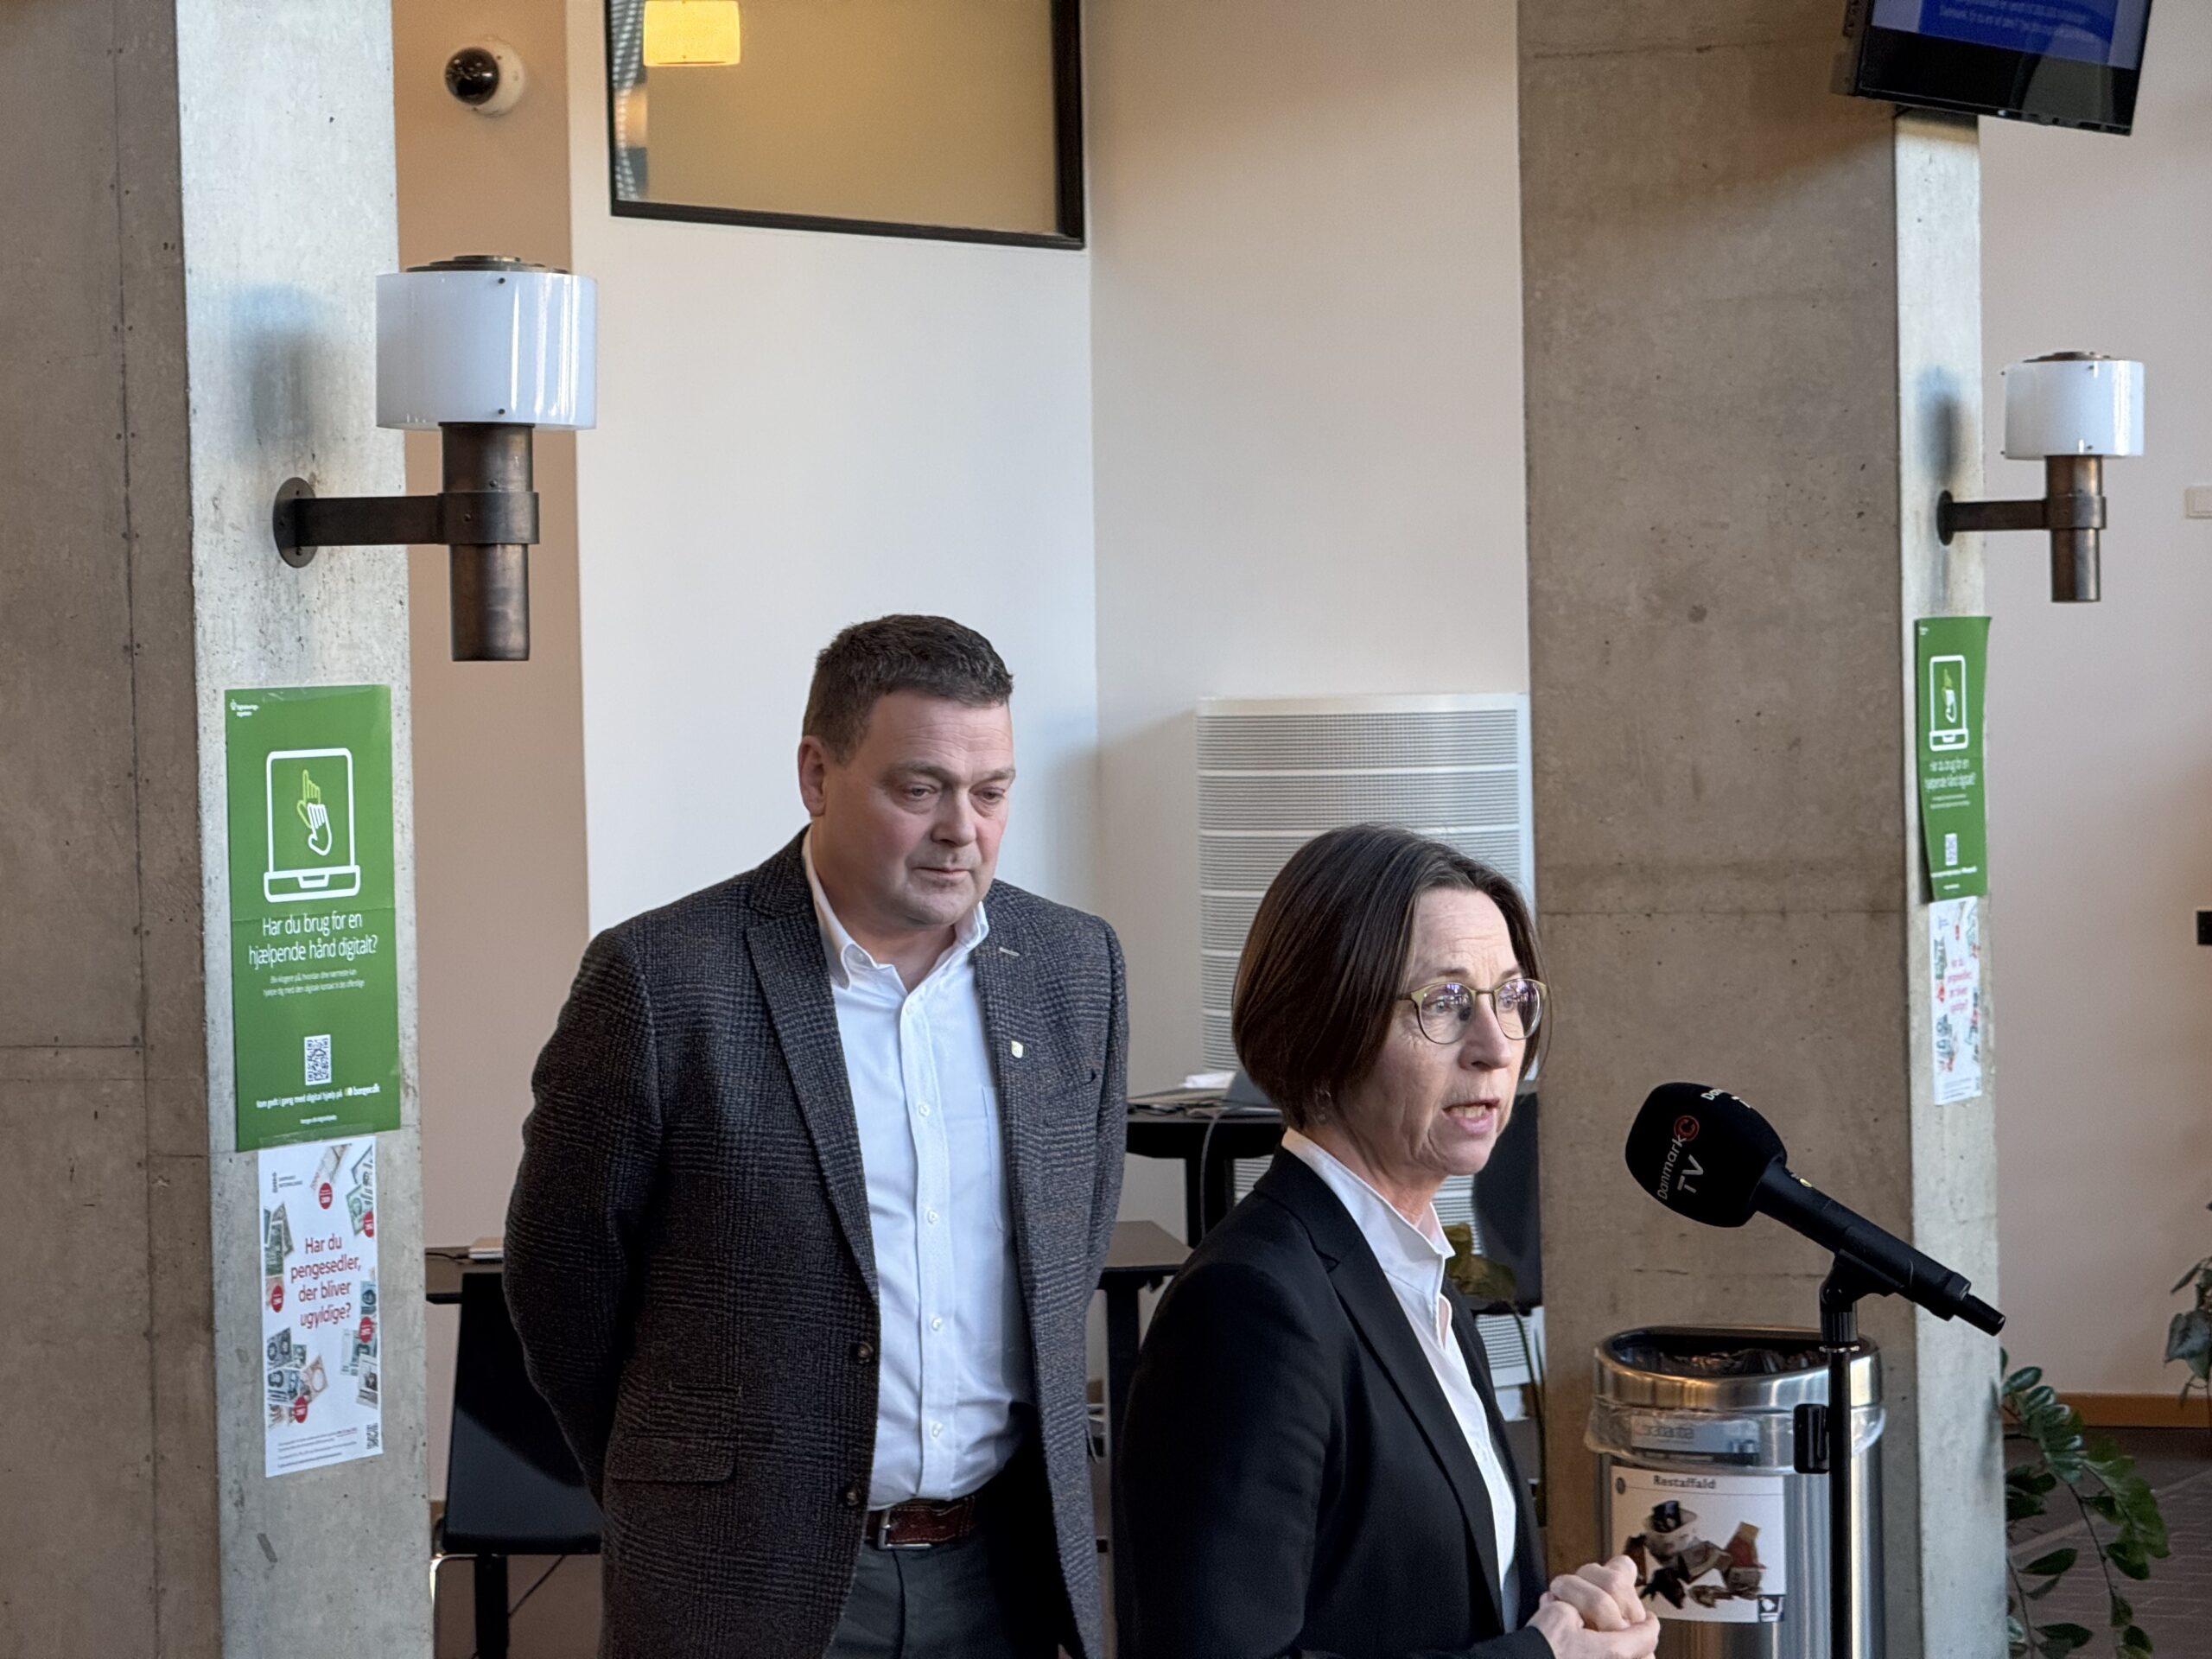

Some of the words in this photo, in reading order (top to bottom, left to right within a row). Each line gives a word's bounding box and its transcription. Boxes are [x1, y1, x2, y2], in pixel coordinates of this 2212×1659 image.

[263, 918, 282, 936] Har
[285, 915, 301, 934] du
[303, 913, 330, 937] brug
[332, 911, 346, 930] for
[348, 913, 363, 929] en
[249, 941, 307, 970] hjælpende
[309, 938, 336, 959] hånd
[338, 934, 378, 961] digitalt?
[1676, 1154, 1704, 1194] TV
[305, 1237, 325, 1254] Har
[328, 1233, 342, 1250] du
[291, 1254, 361, 1284] pengesedler,
[299, 1283, 318, 1302] der
[321, 1280, 352, 1299] bliver
[300, 1302, 352, 1329] ugyldige?
